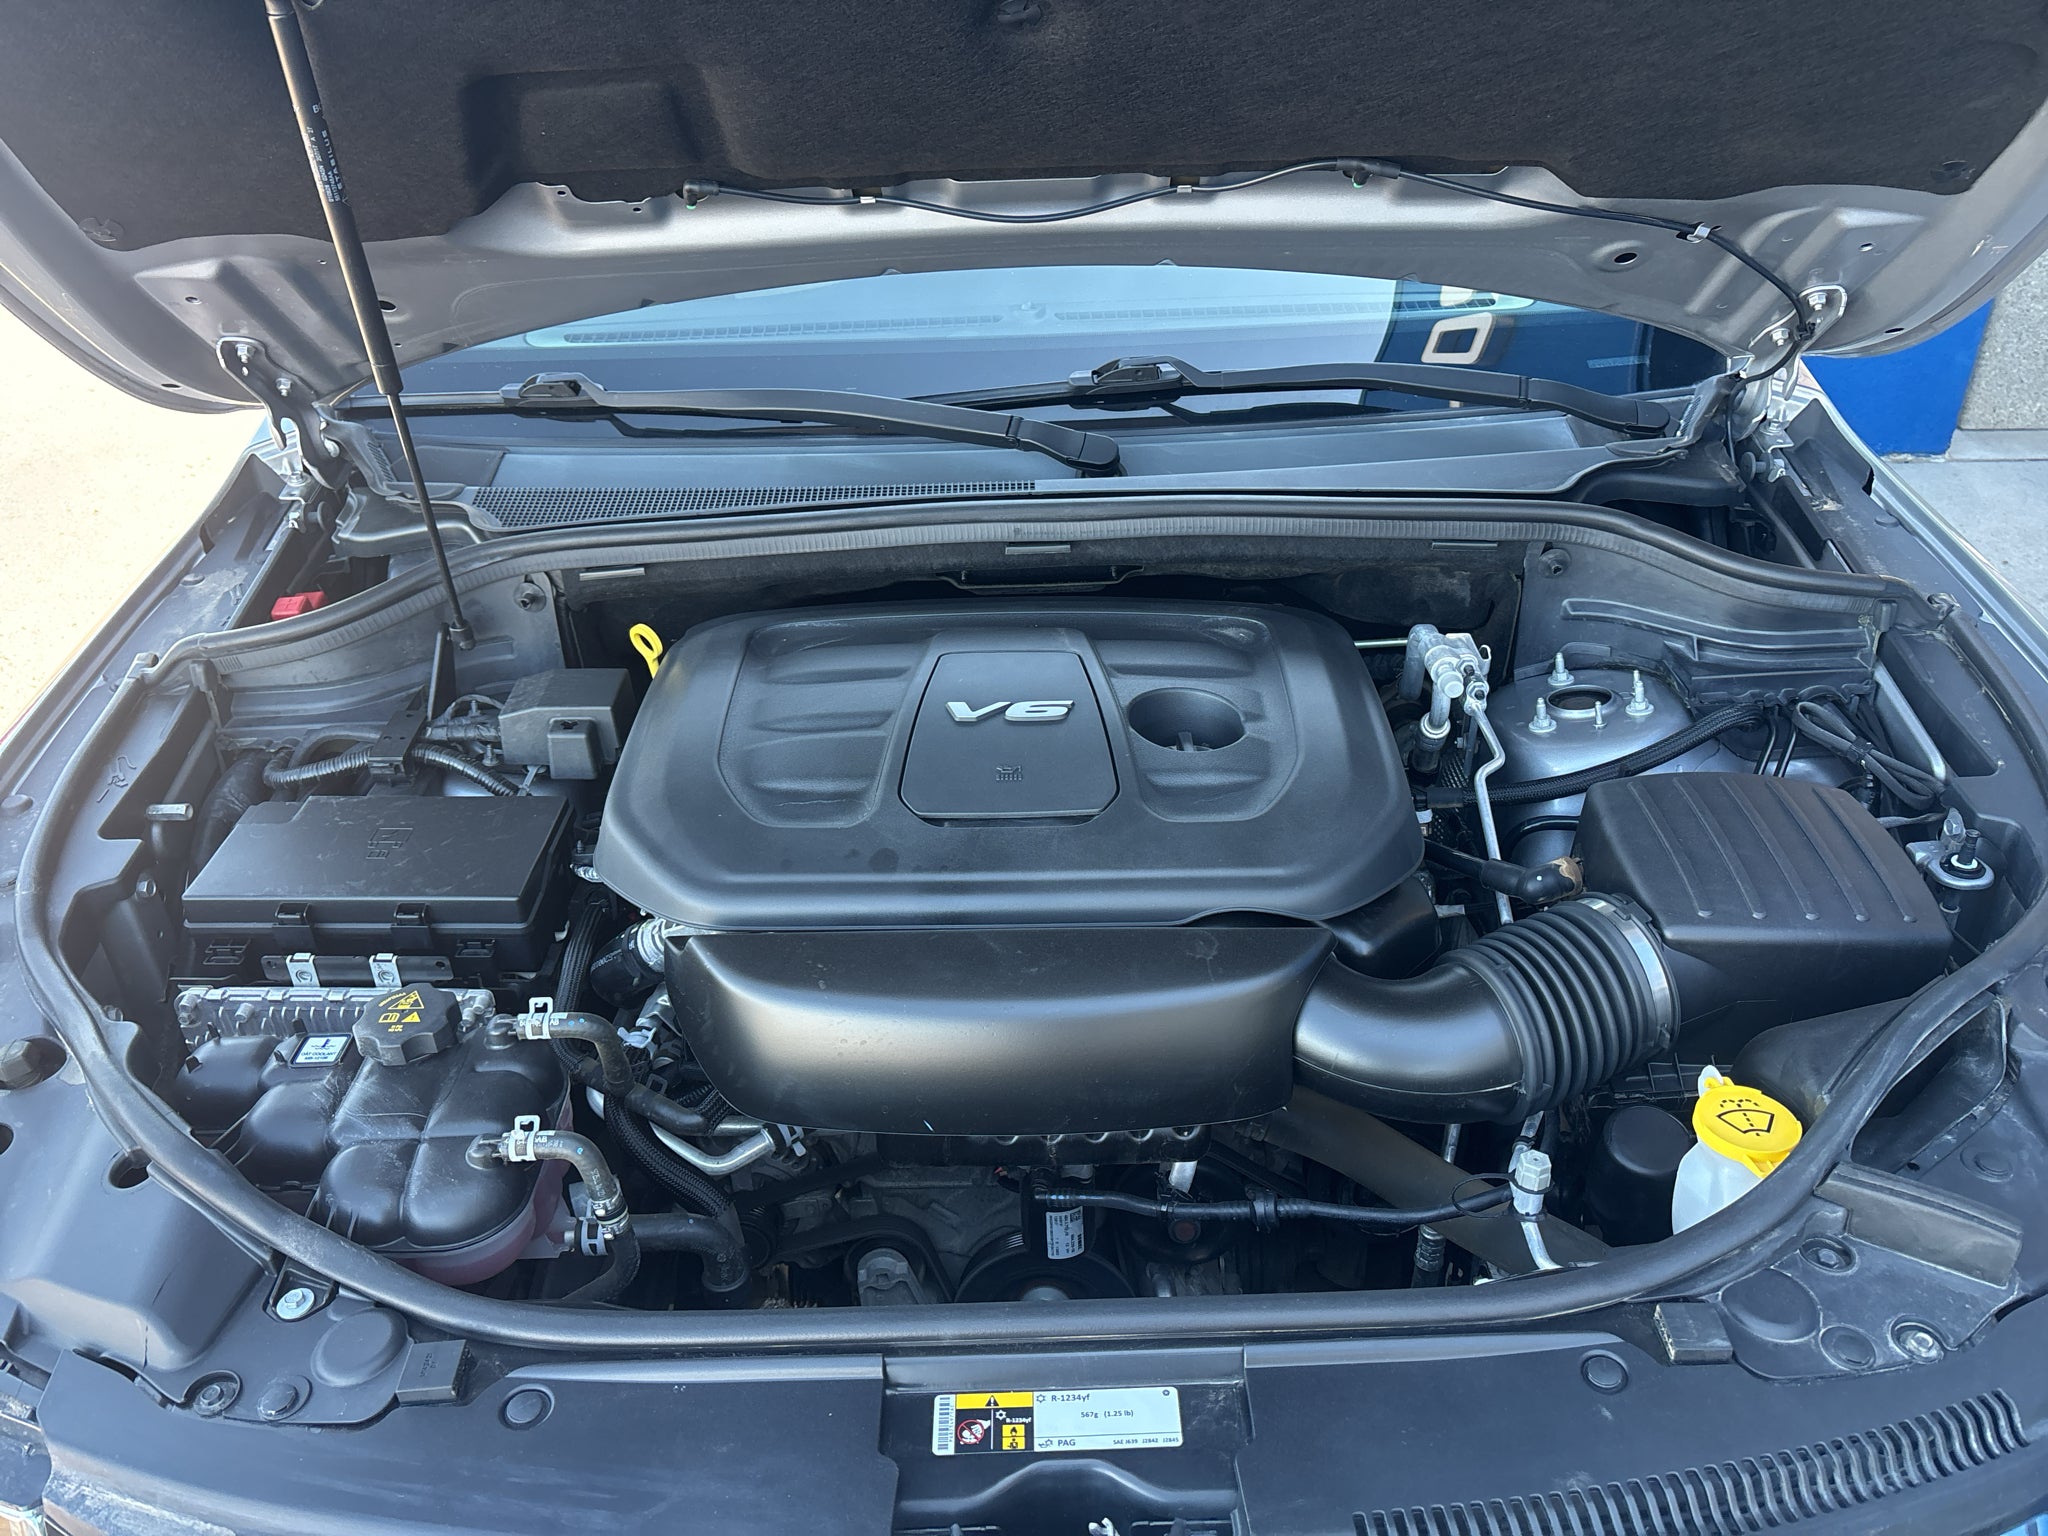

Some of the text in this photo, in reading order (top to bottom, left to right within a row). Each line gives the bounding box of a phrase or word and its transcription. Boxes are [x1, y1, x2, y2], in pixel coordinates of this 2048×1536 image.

[321, 129, 343, 190] STABILUS
[945, 700, 1074, 722] V6
[1051, 1393, 1090, 1402] R-1234yf
[1103, 1410, 1123, 1418] (1.25
[1124, 1409, 1134, 1417] lb)
[1057, 1439, 1076, 1447] PAG
